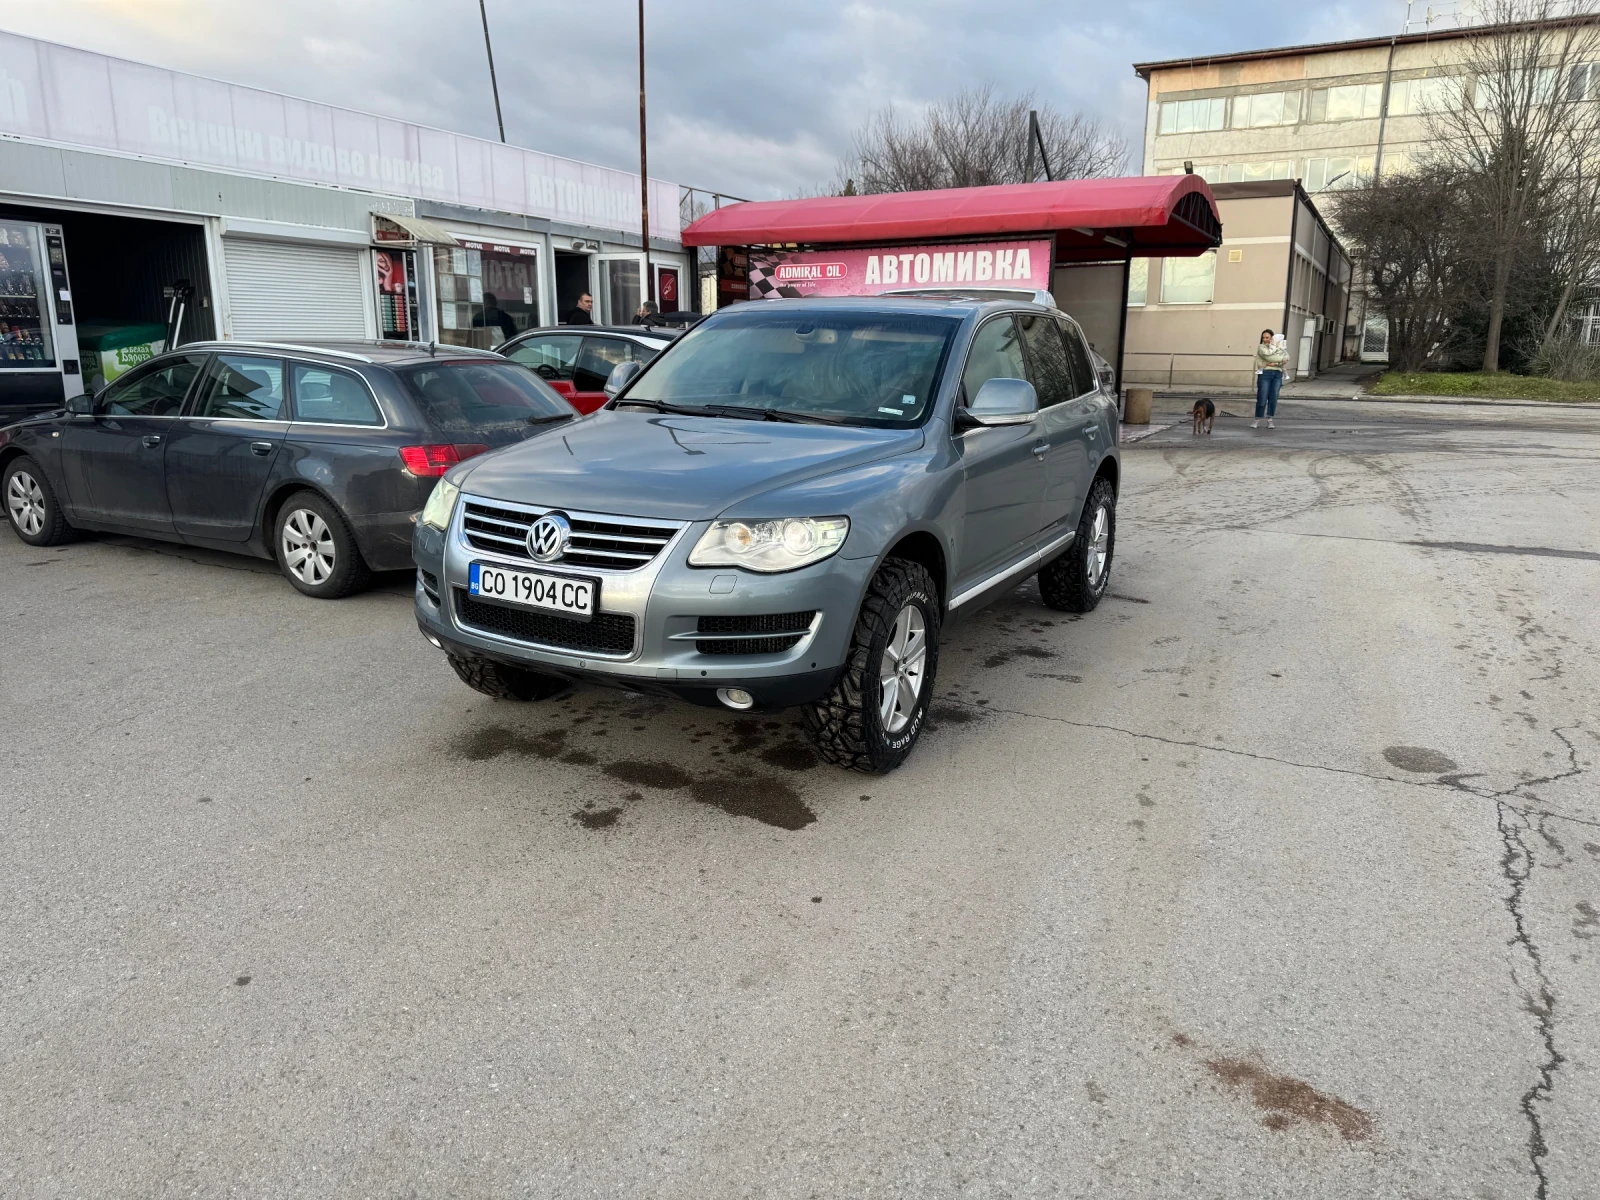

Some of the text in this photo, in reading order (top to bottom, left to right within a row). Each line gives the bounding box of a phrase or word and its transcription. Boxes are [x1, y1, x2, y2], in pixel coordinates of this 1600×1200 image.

[148, 106, 445, 190] Всички видове горива
[465, 241, 536, 256] MOTUL MOTUL MOTUL
[780, 265, 841, 279] ADMIRAL OIL
[865, 249, 1031, 284] АВТОМИВКА
[471, 581, 480, 589] BG
[512, 574, 557, 605] 1904
[561, 583, 588, 610] CC
[891, 707, 923, 749] MUD RAGE
